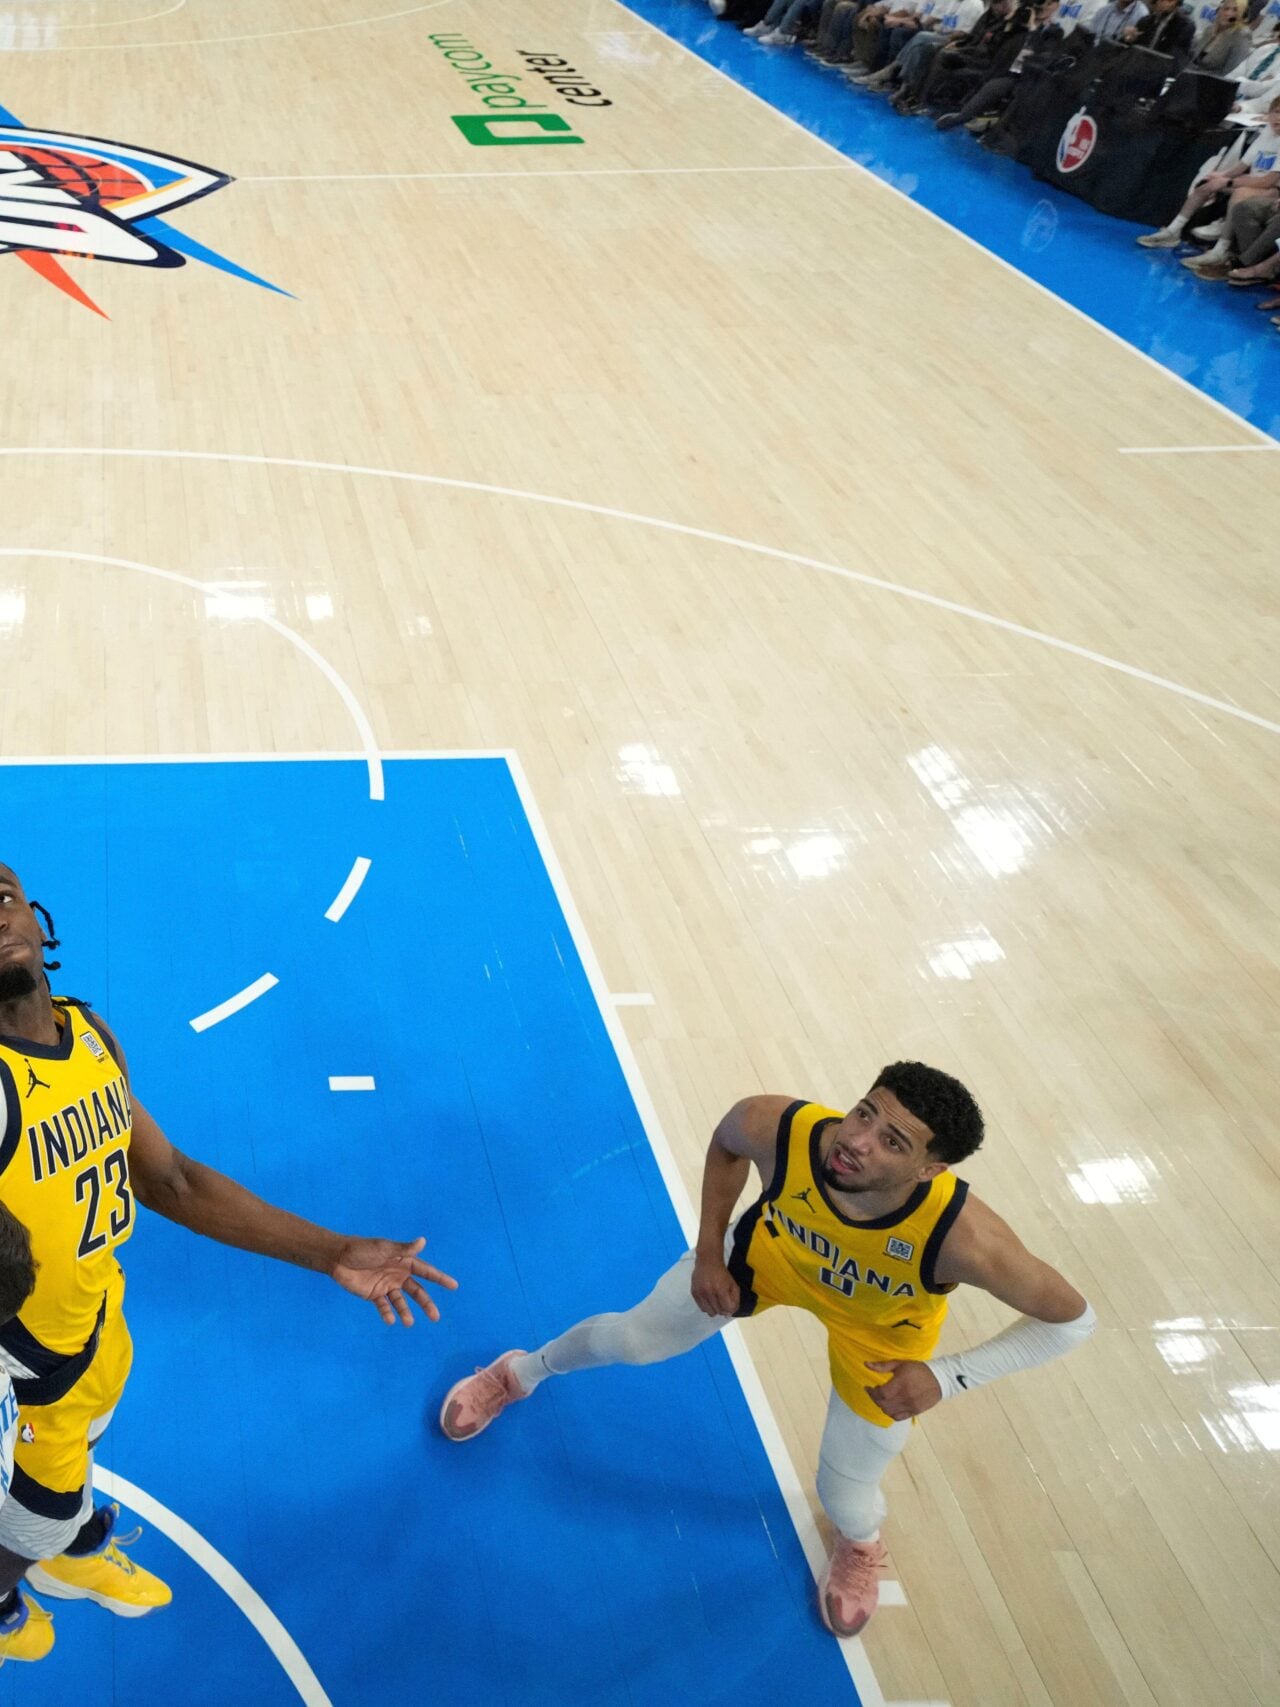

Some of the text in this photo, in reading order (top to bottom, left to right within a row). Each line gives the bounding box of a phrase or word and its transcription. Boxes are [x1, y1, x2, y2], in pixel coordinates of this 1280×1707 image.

[428, 33, 548, 109] paycom
[516, 50, 613, 107] center
[75, 1147, 131, 1259] 23
[776, 1207, 916, 1298] INDIANA
